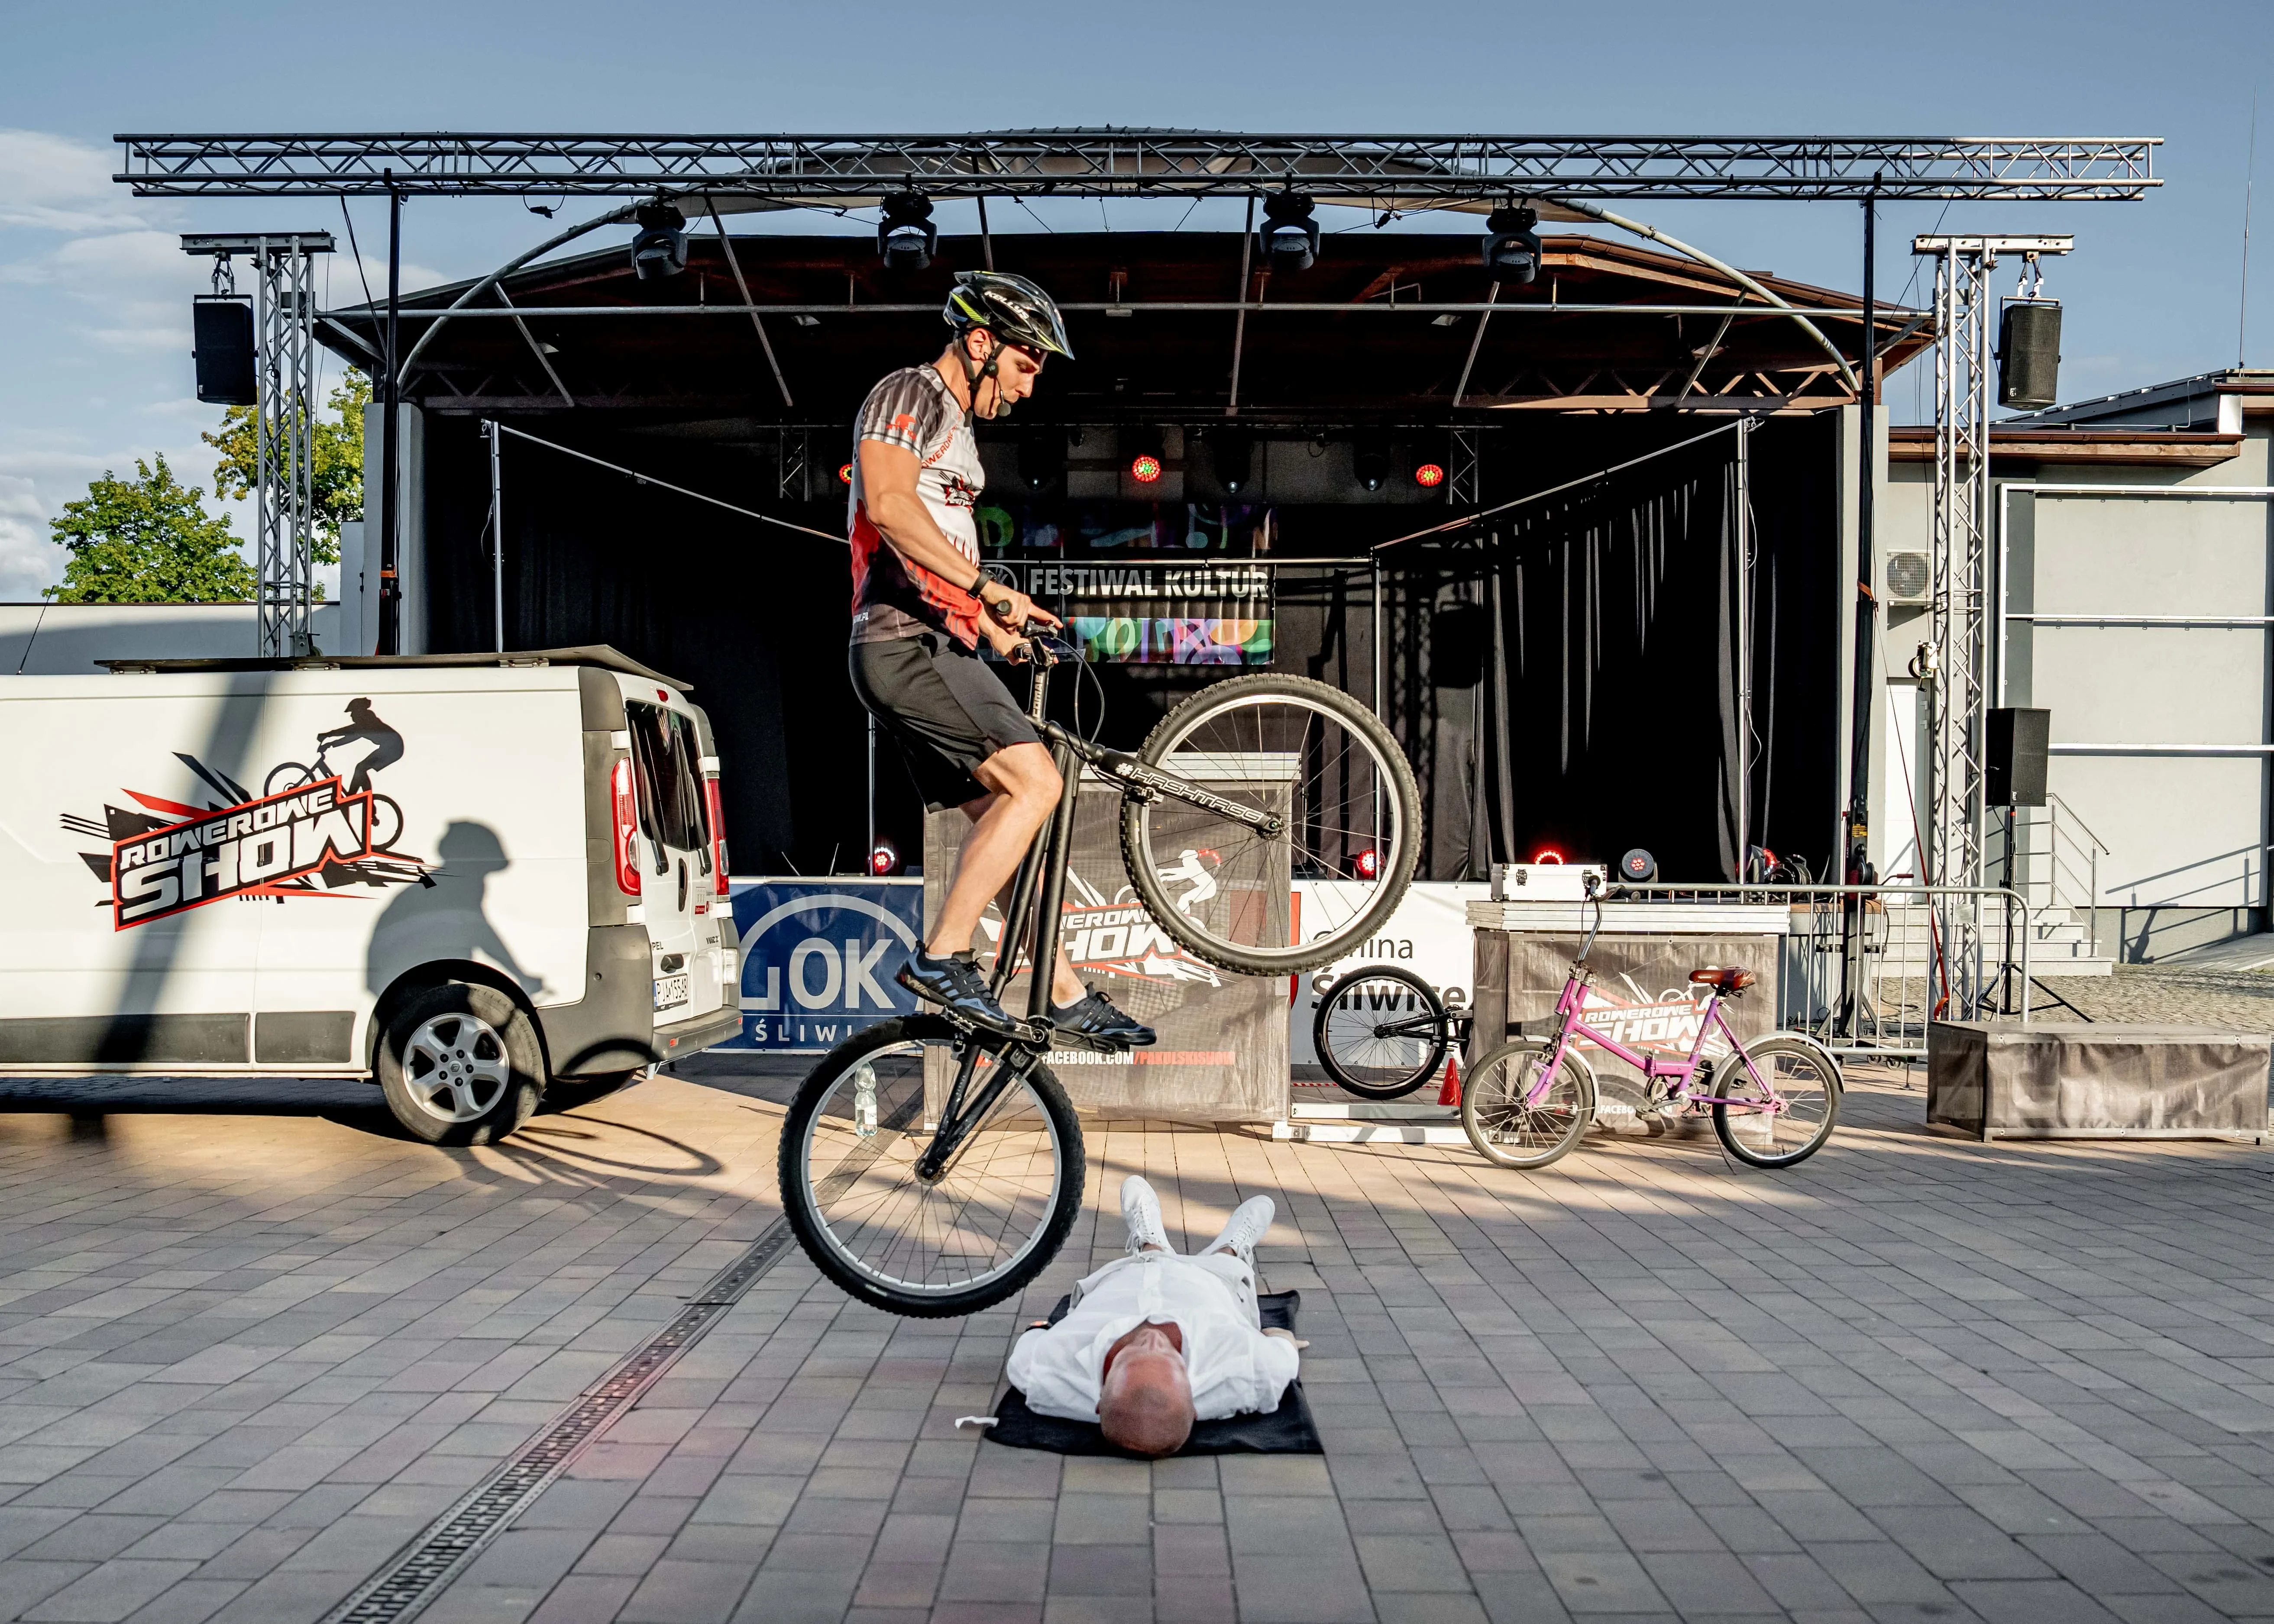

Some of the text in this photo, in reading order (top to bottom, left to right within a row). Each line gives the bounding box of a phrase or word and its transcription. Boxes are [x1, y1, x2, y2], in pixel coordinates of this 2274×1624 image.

[1031, 569, 1158, 596] FESTIWAL
[1165, 570, 1269, 598] KULTUR
[120, 787, 336, 869] ROWEROWE
[120, 802, 363, 920] SHOW
[652, 942, 663, 950] PEL
[1059, 923, 1178, 962] HOW
[1585, 1004, 1693, 1023] ROWEROWE
[755, 1018, 873, 1042] ŚLIWI
